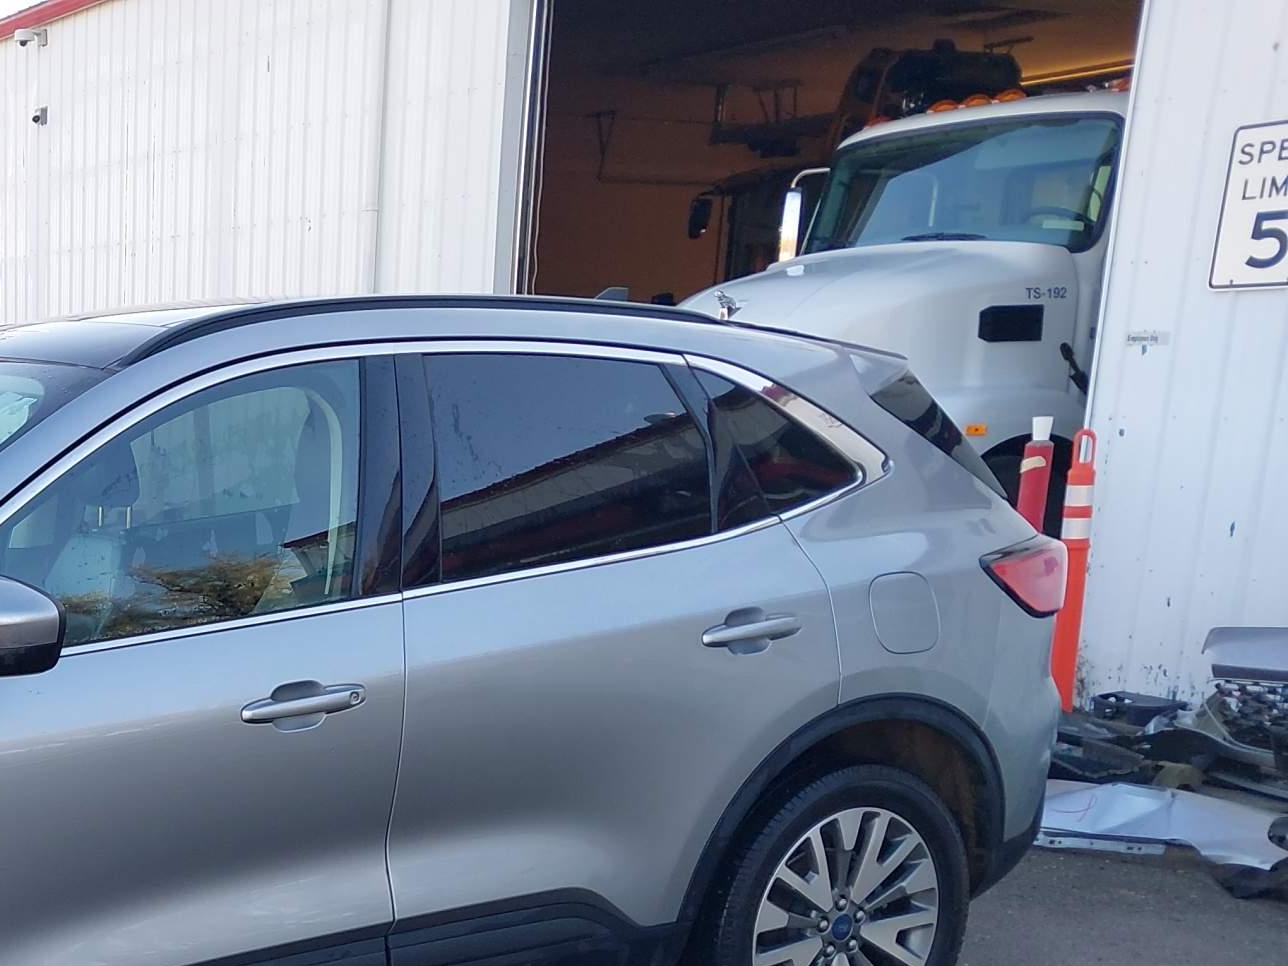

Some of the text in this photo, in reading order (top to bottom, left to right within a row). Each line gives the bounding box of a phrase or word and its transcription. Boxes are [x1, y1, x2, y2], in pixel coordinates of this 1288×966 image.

[1238, 138, 1288, 166] SPE
[1244, 208, 1288, 269] 5
[1025, 286, 1068, 300] TS-192
